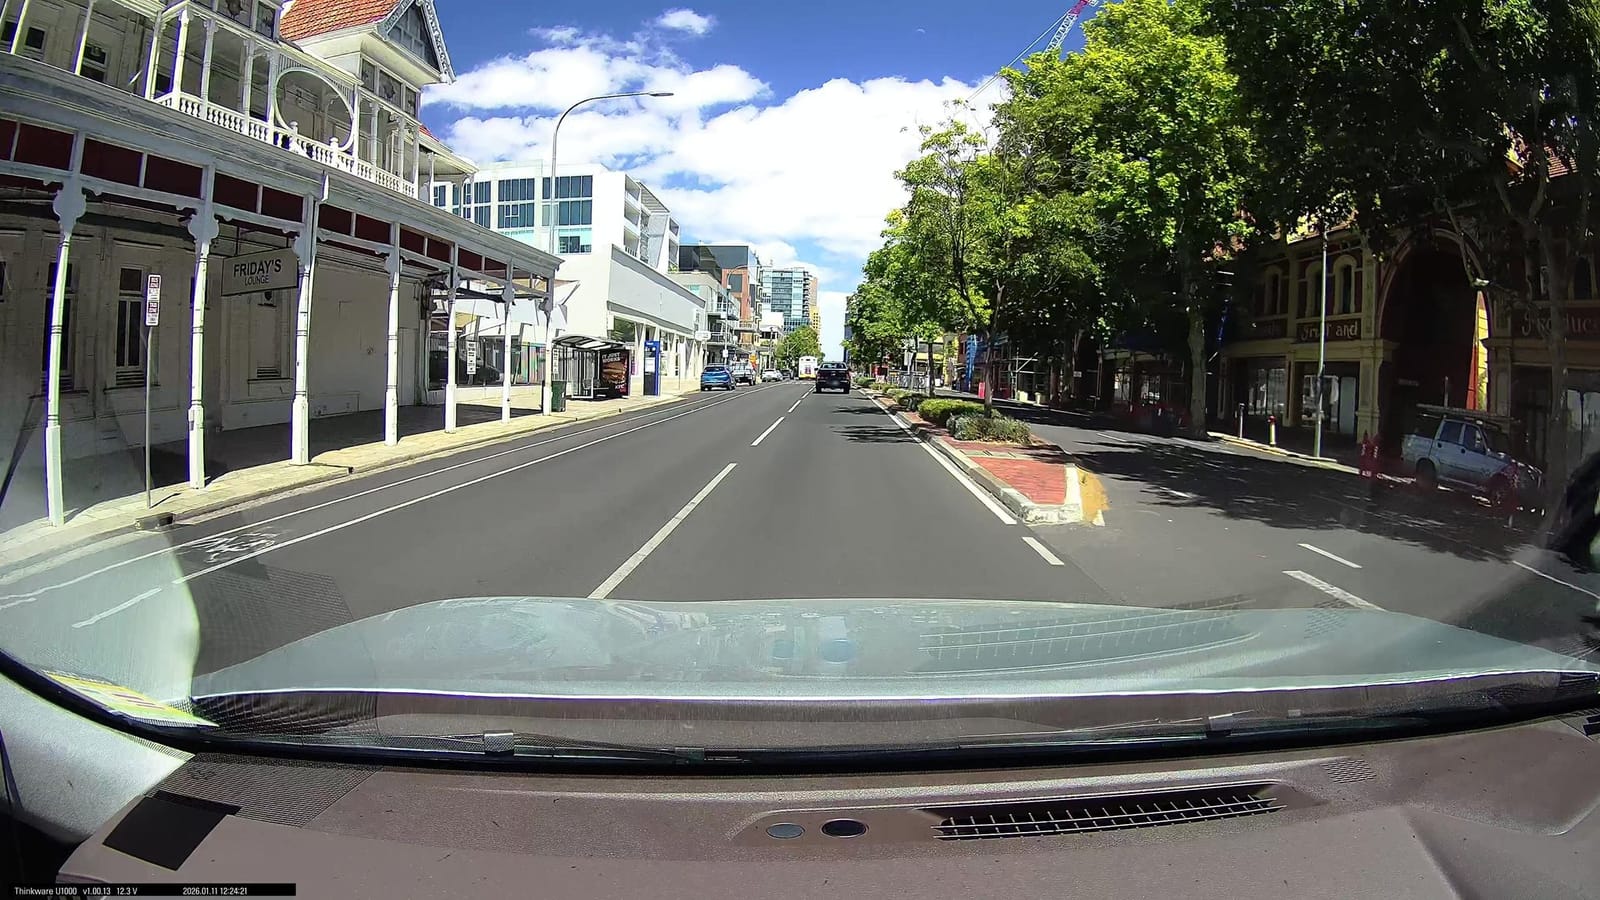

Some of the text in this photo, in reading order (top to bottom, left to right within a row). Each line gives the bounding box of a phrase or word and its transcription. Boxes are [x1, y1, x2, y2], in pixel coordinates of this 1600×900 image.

[234, 259, 281, 277] FRIDAY'S
[245, 275, 269, 286] LOUNGE
[1336, 320, 1358, 339] and
